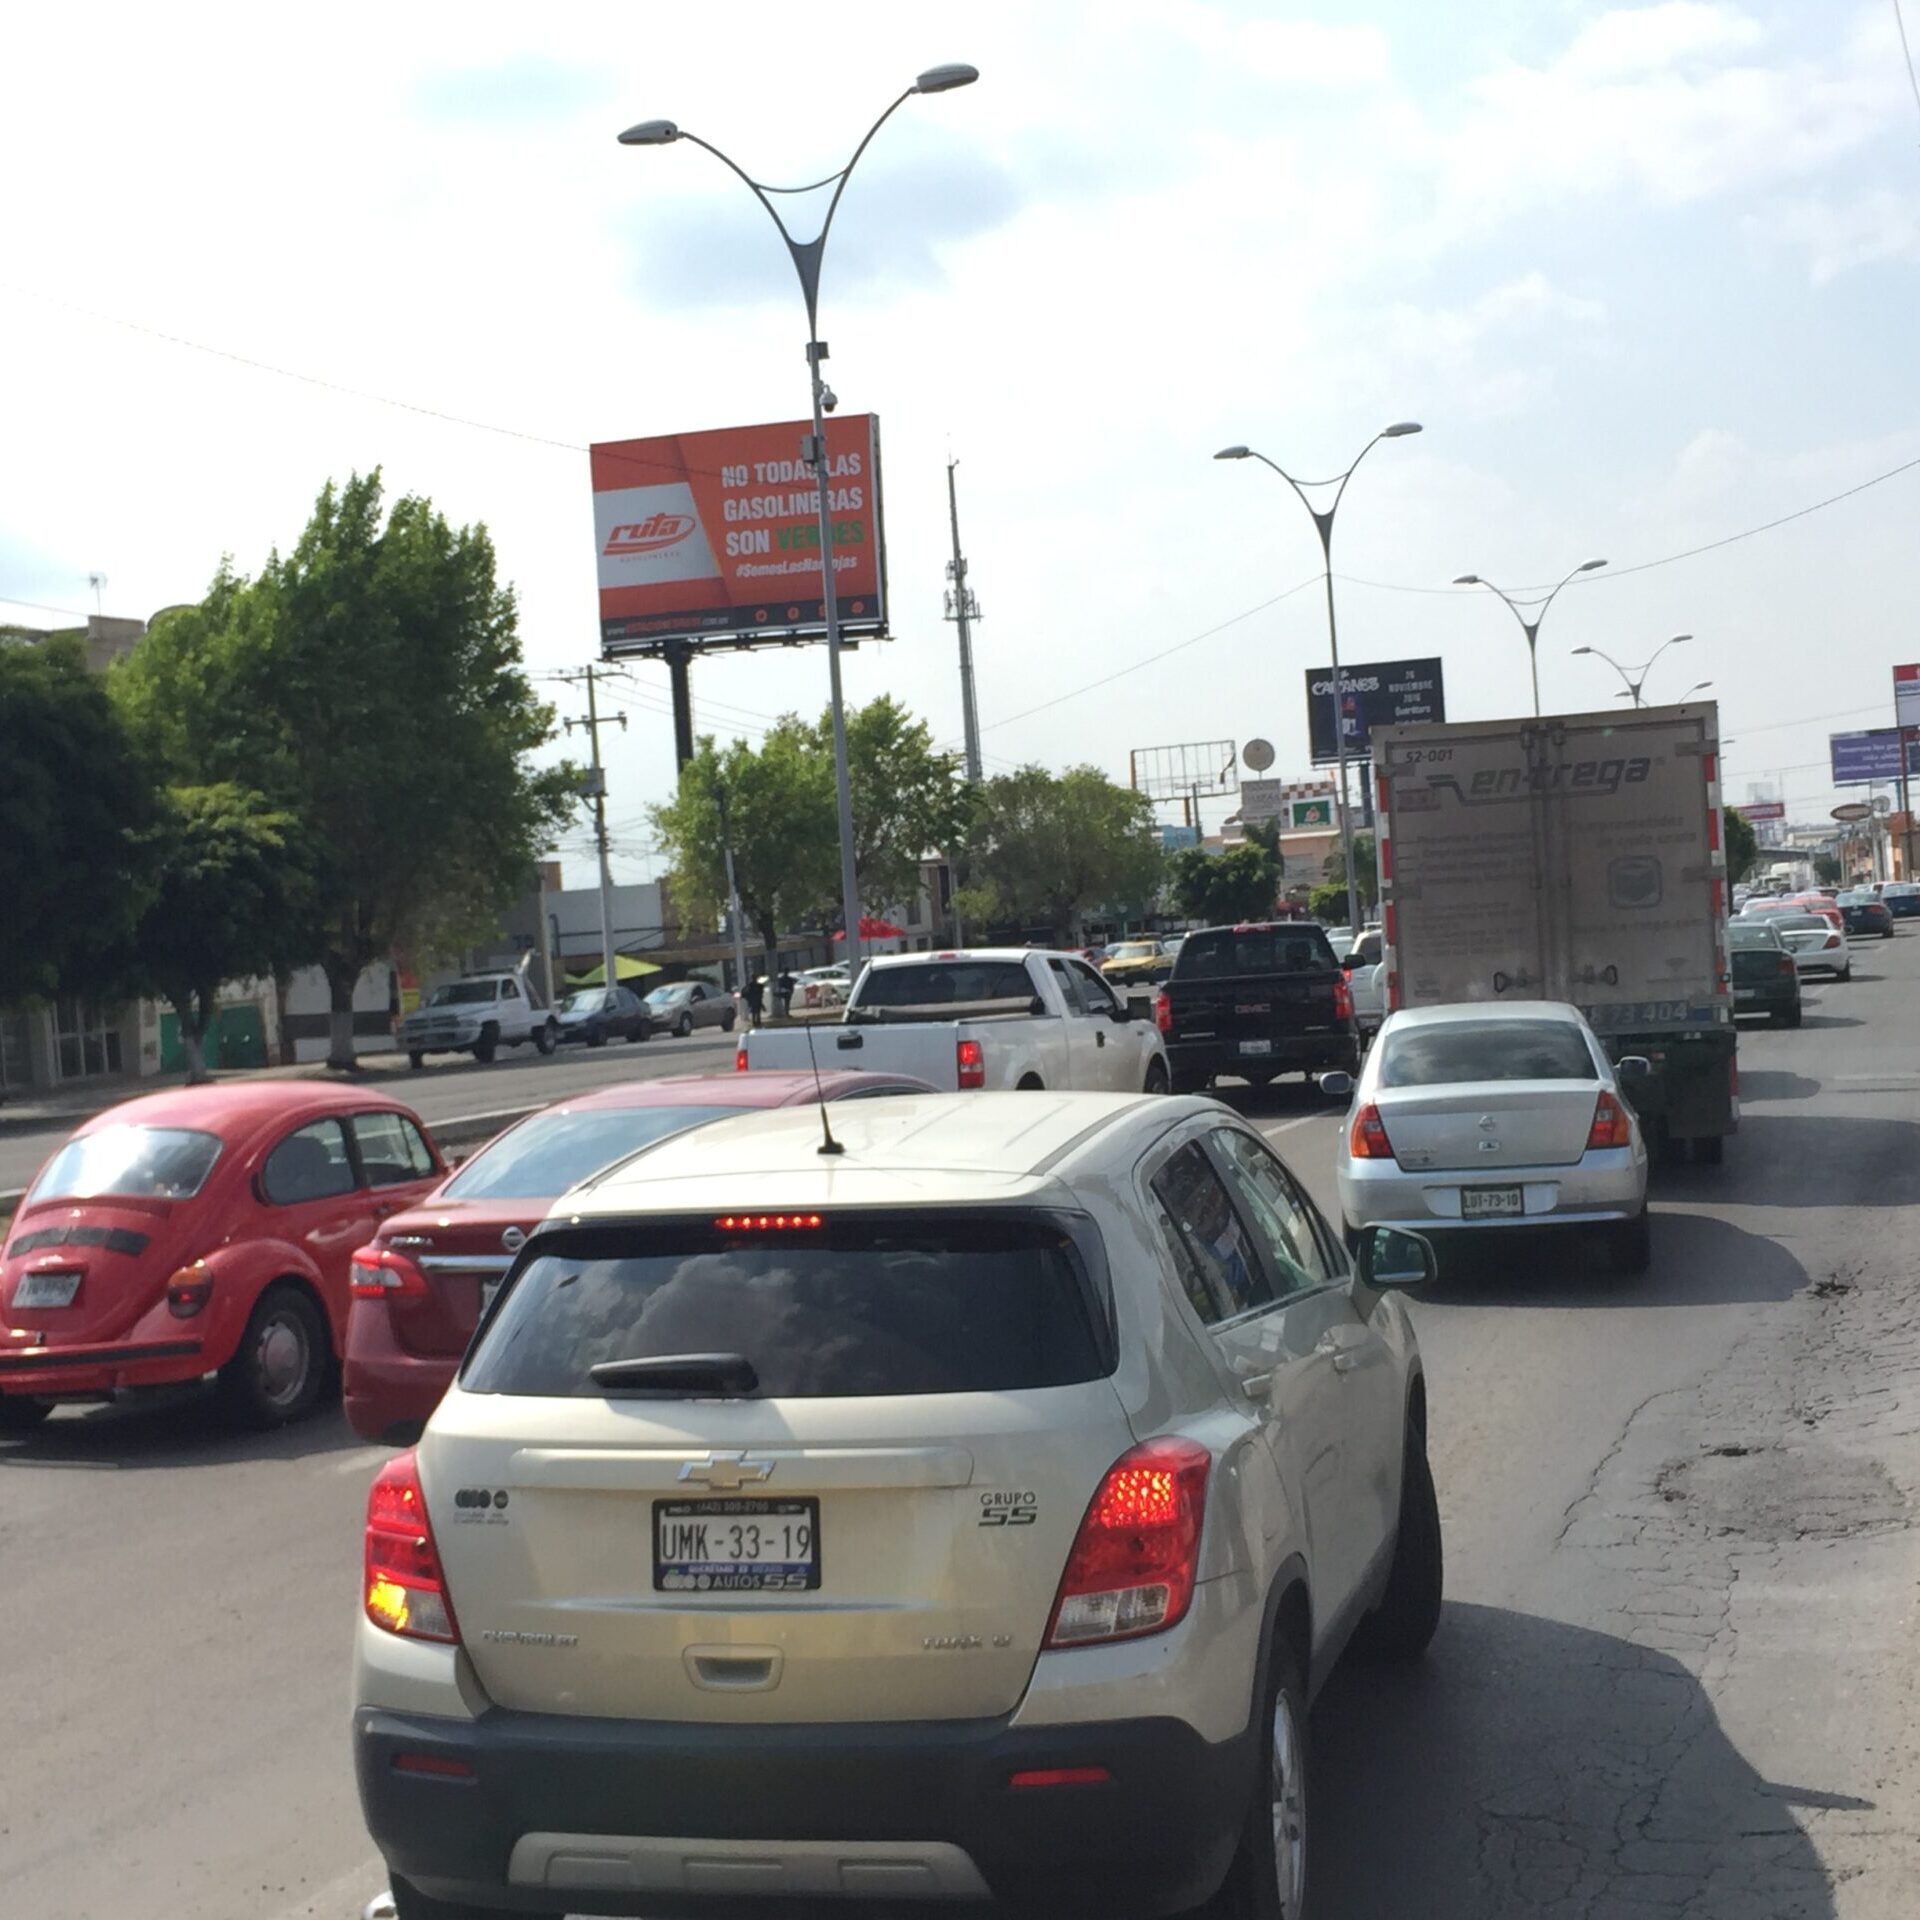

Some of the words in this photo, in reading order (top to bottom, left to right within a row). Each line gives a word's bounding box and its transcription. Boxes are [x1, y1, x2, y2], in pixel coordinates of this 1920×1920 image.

[721, 465, 749, 488] NO
[824, 453, 862, 477] LAS
[723, 487, 864, 522] GASOLINERAS
[726, 529, 771, 557] SON
[775, 520, 865, 551] VERES
[1234, 1003, 1271, 1014] GMC
[980, 1491, 1037, 1506] GRUPO
[978, 1506, 1038, 1527] SS
[662, 1523, 811, 1561] UMK-33-19
[713, 1575, 761, 1589] AUTOS
